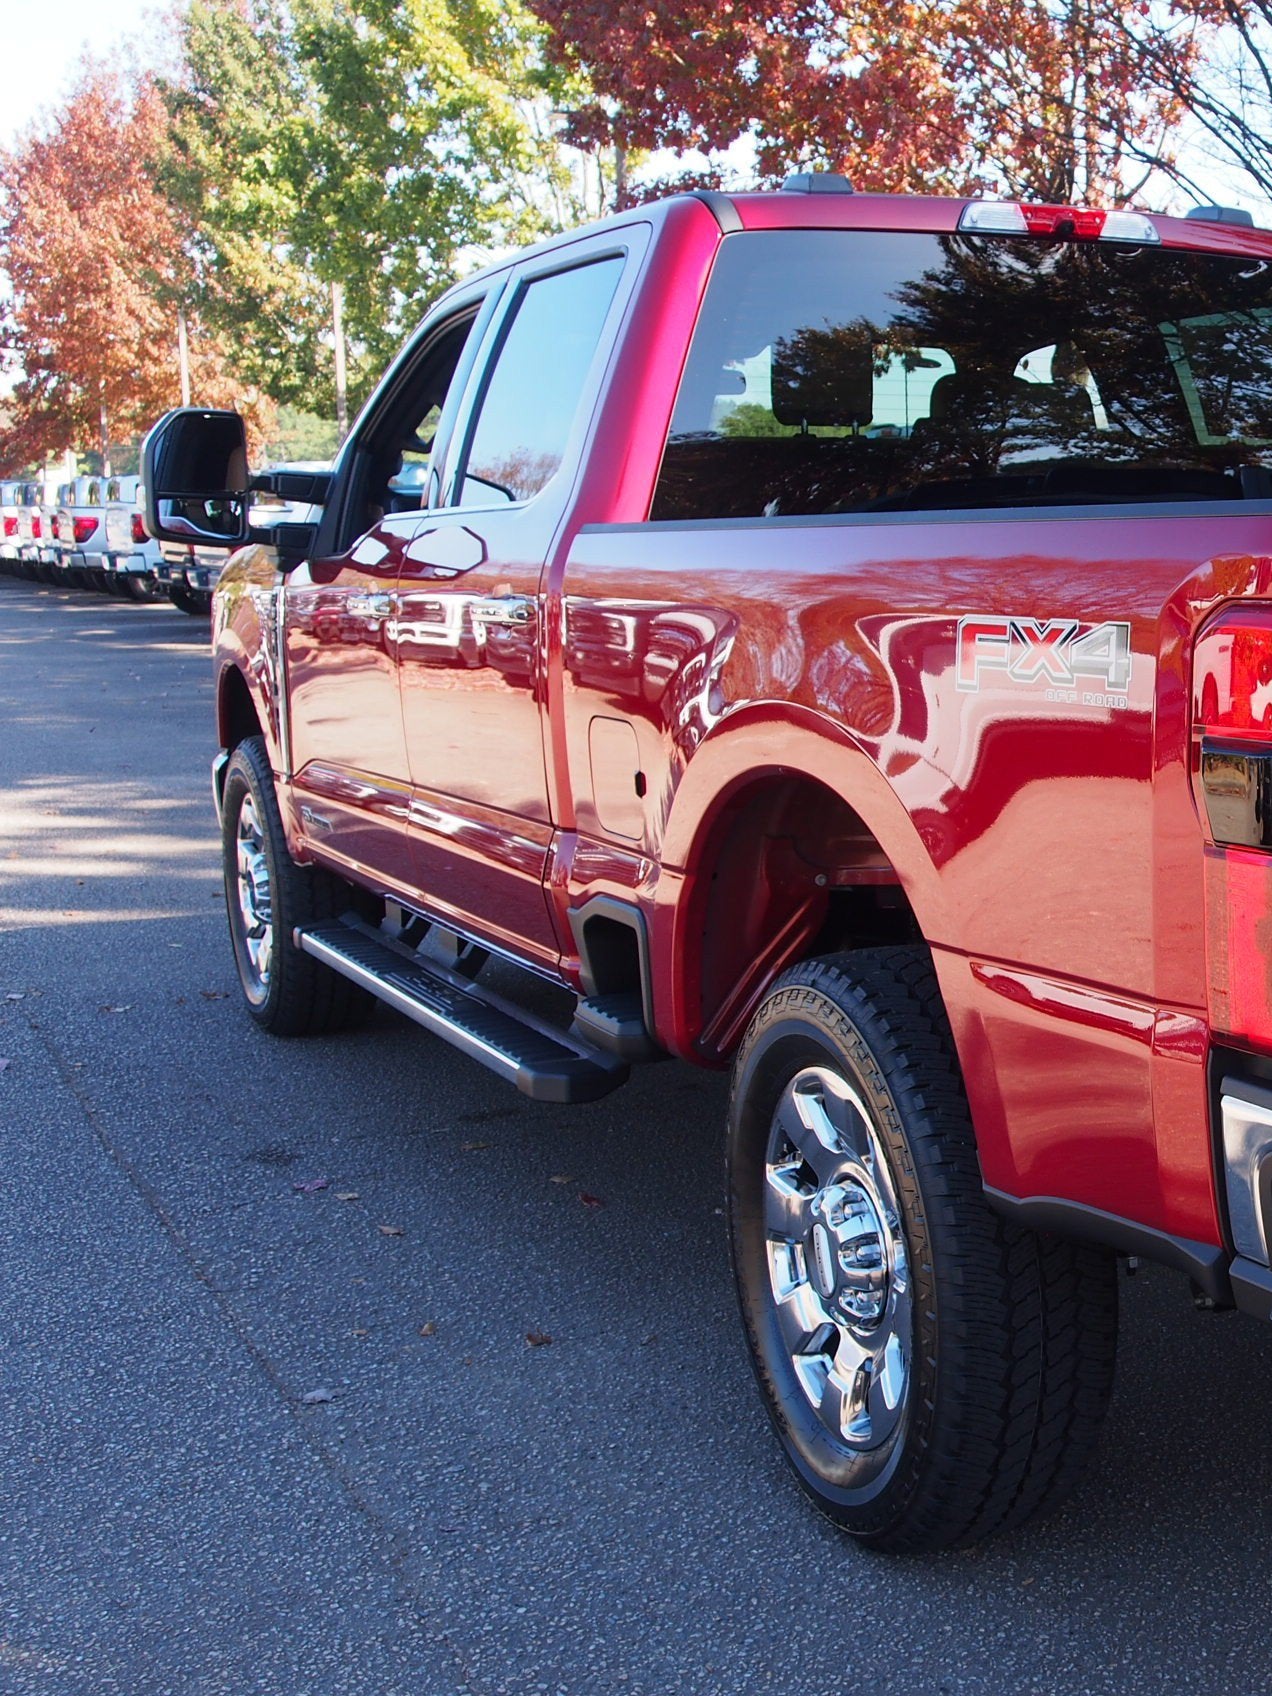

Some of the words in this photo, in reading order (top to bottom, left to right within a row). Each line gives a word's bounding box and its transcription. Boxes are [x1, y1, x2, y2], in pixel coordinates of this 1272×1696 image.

[956, 614, 1132, 692] FX4
[1046, 689, 1076, 704] OFF
[1082, 692, 1128, 709] ROAD
